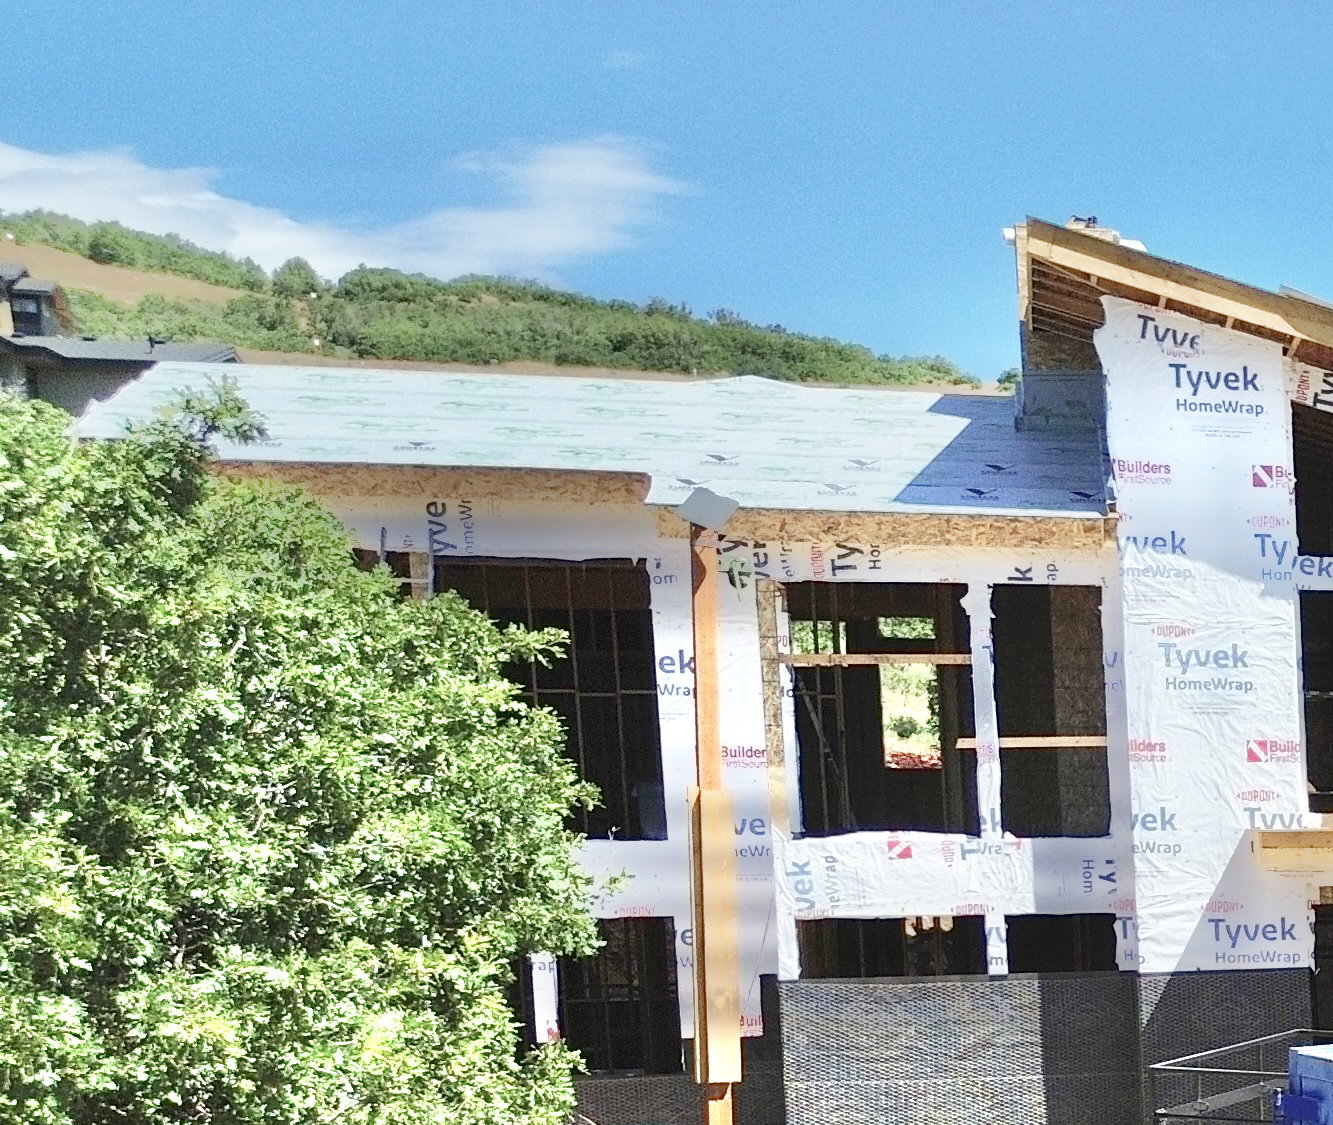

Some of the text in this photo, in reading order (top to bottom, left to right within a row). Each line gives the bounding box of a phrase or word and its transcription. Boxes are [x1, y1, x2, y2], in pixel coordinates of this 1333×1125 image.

[1169, 363, 1260, 396] Tyvek
[1176, 398, 1264, 417] HomeWrap
[1117, 460, 1171, 475] Builders
[1158, 641, 1249, 675] Tyvek
[1165, 677, 1255, 695] HomeWrap
[1129, 739, 1166, 752] ilders
[1131, 806, 1177, 832] vek
[1131, 841, 1182, 856] eWrap
[1208, 917, 1297, 948] Tyvek
[1215, 951, 1301, 965] HomeWrap
